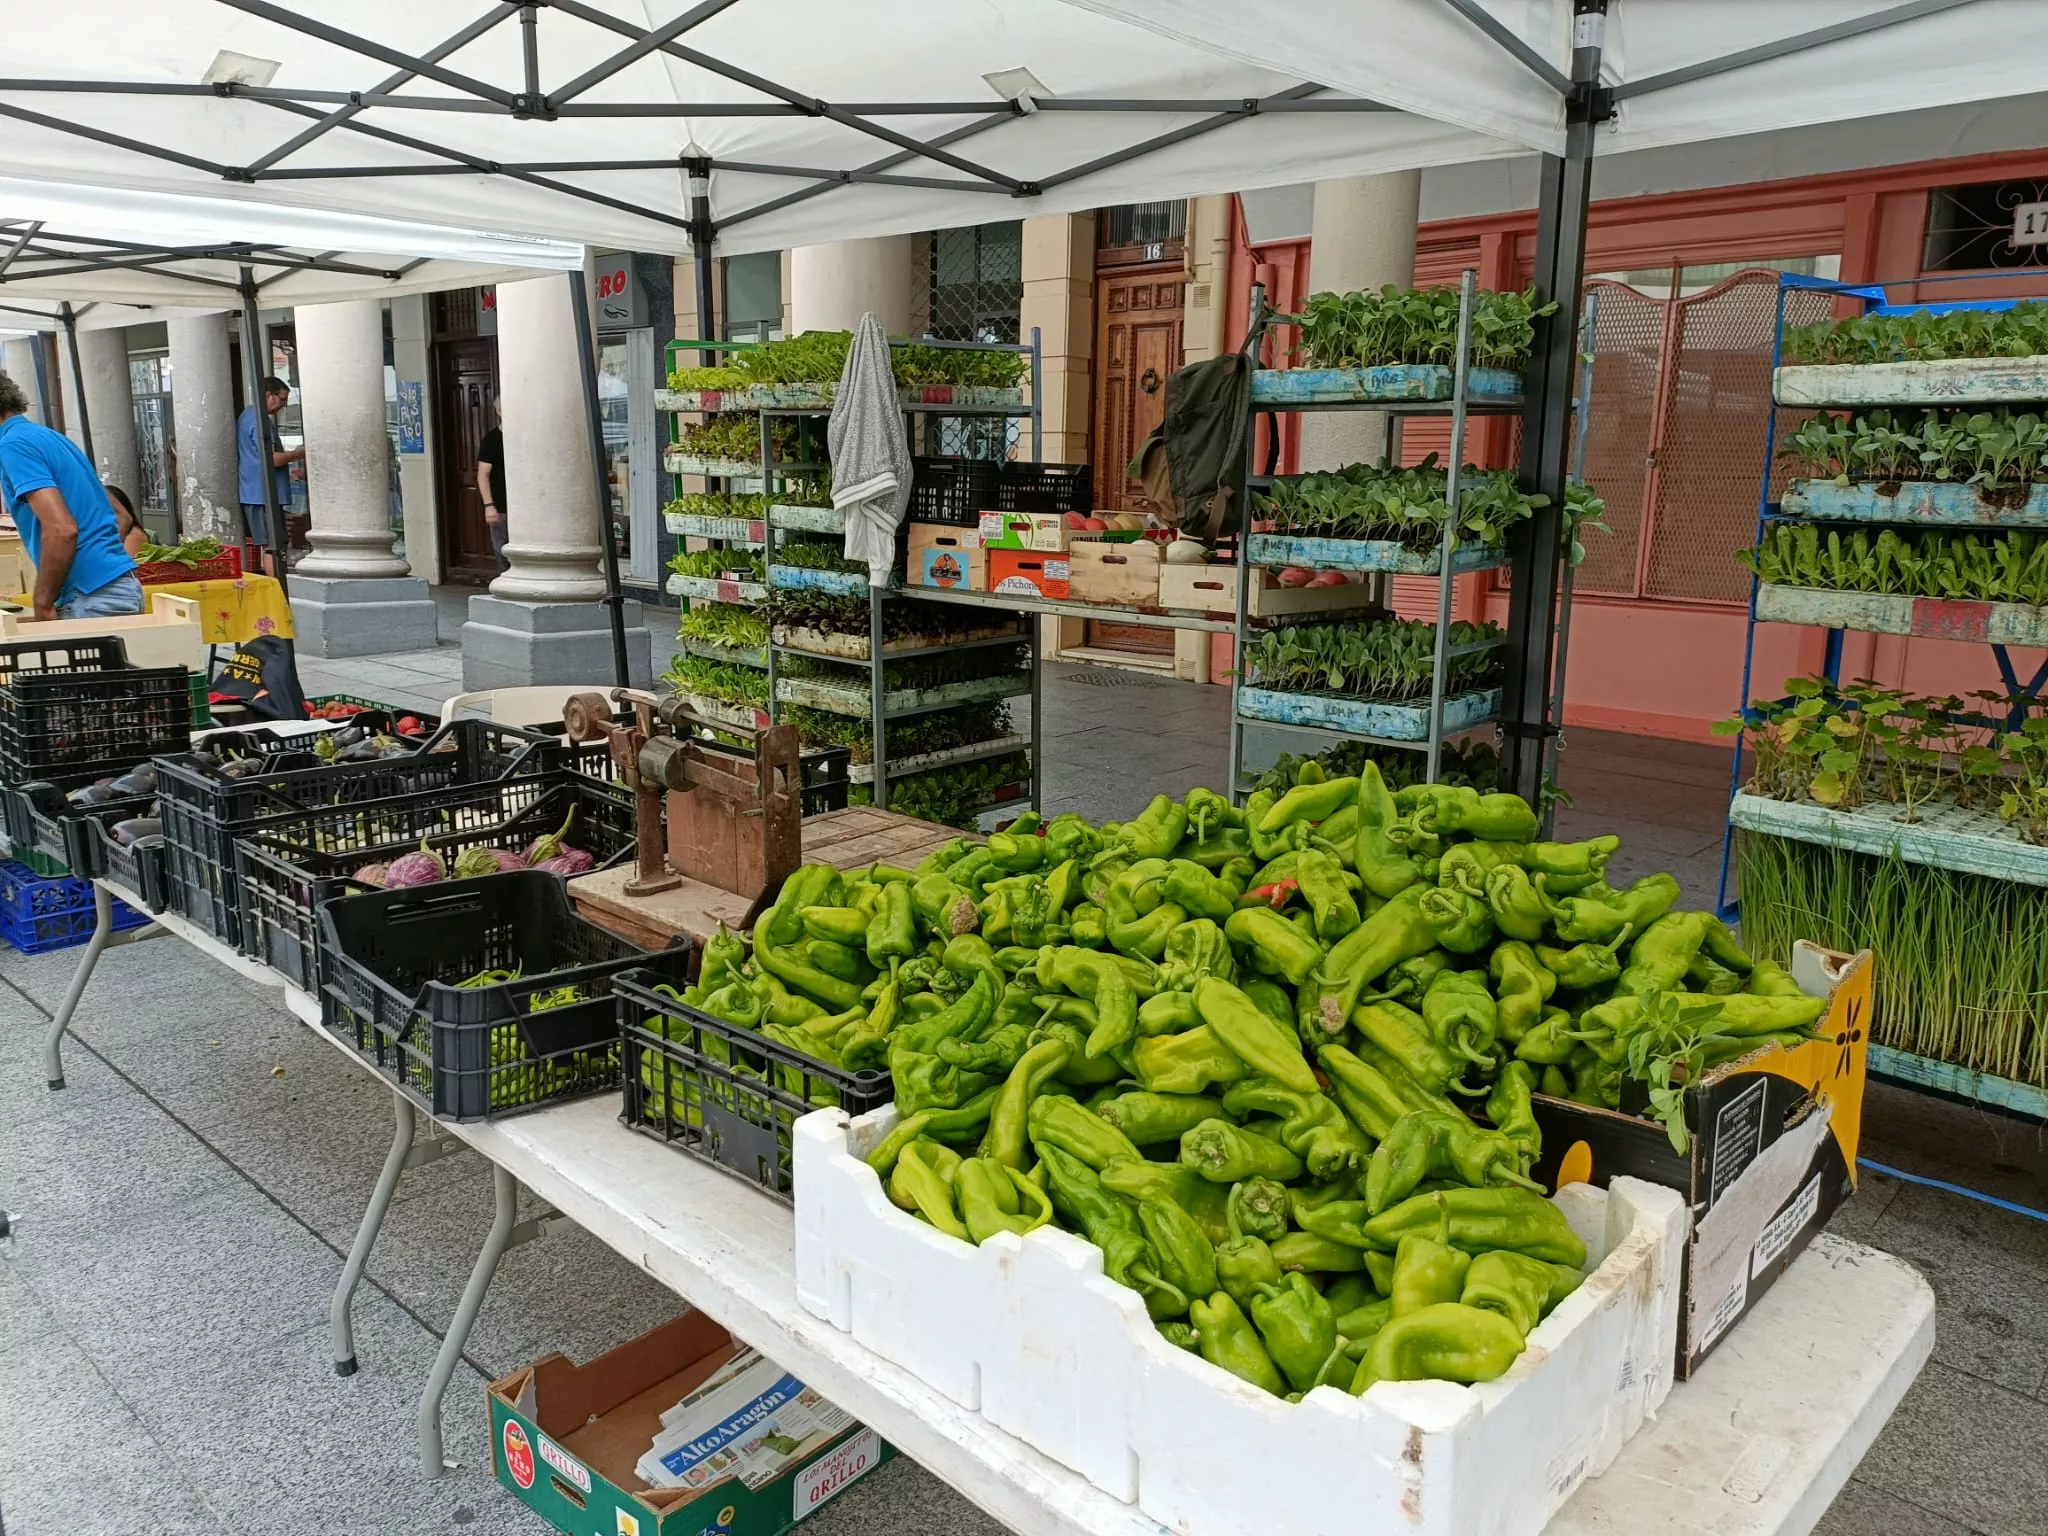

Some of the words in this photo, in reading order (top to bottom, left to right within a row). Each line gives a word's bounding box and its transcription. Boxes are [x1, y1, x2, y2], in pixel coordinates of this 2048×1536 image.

[2024, 211, 2048, 234] 17
[1147, 245, 1160, 260] 16
[542, 1442, 587, 1487] GRILLO
[829, 1457, 847, 1475] DEL
[803, 1468, 821, 1483] LOS
[809, 1454, 867, 1503] GRILLO
